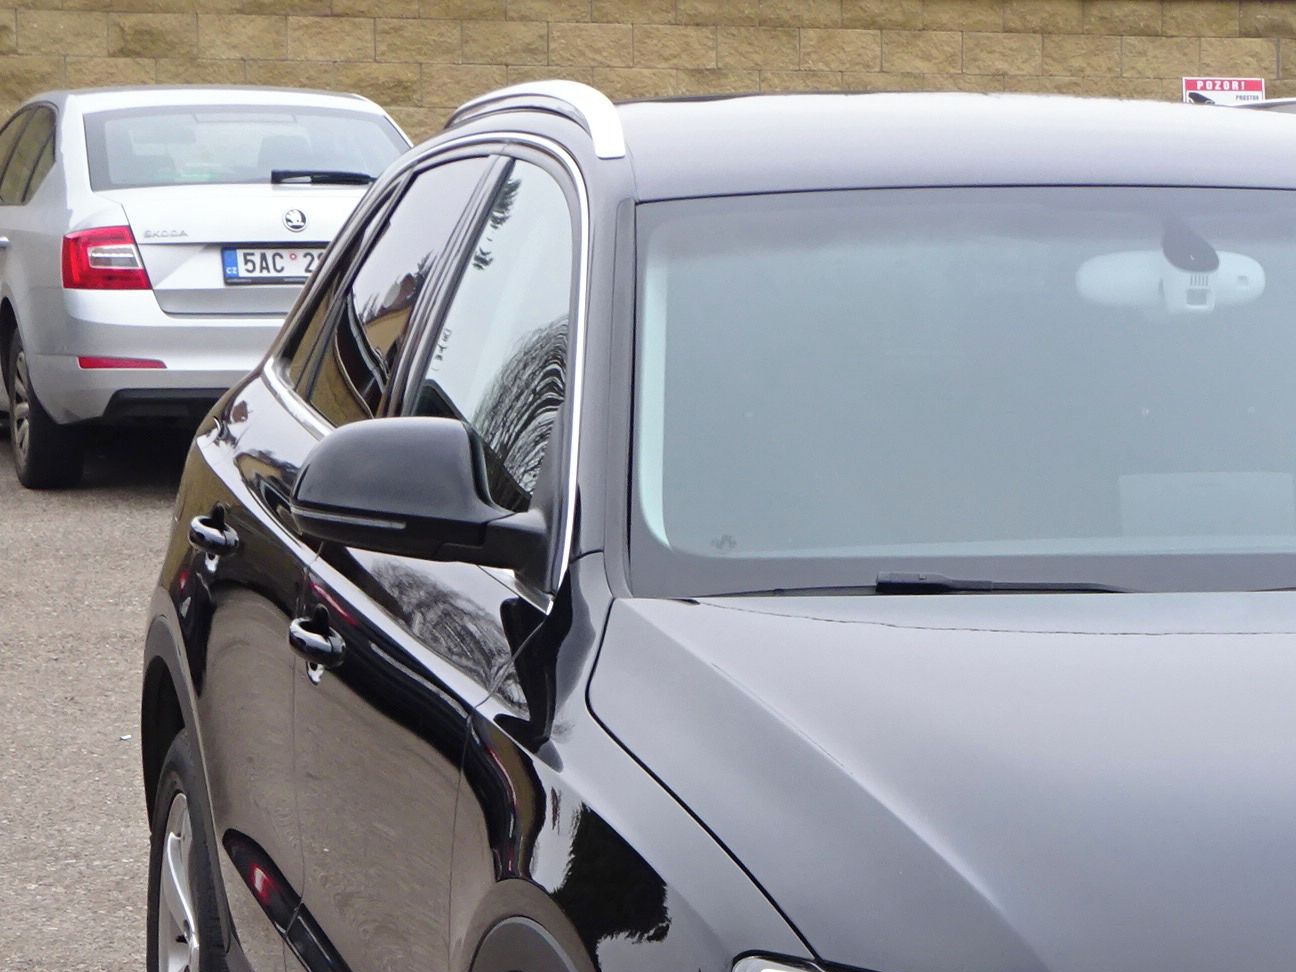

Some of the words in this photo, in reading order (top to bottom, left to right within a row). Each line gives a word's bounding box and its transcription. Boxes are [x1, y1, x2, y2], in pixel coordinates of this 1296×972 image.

[1196, 80, 1246, 90] POZOR!
[243, 252, 285, 274] 5AC
[303, 252, 323, 273] 2
[226, 266, 237, 274] CZ
